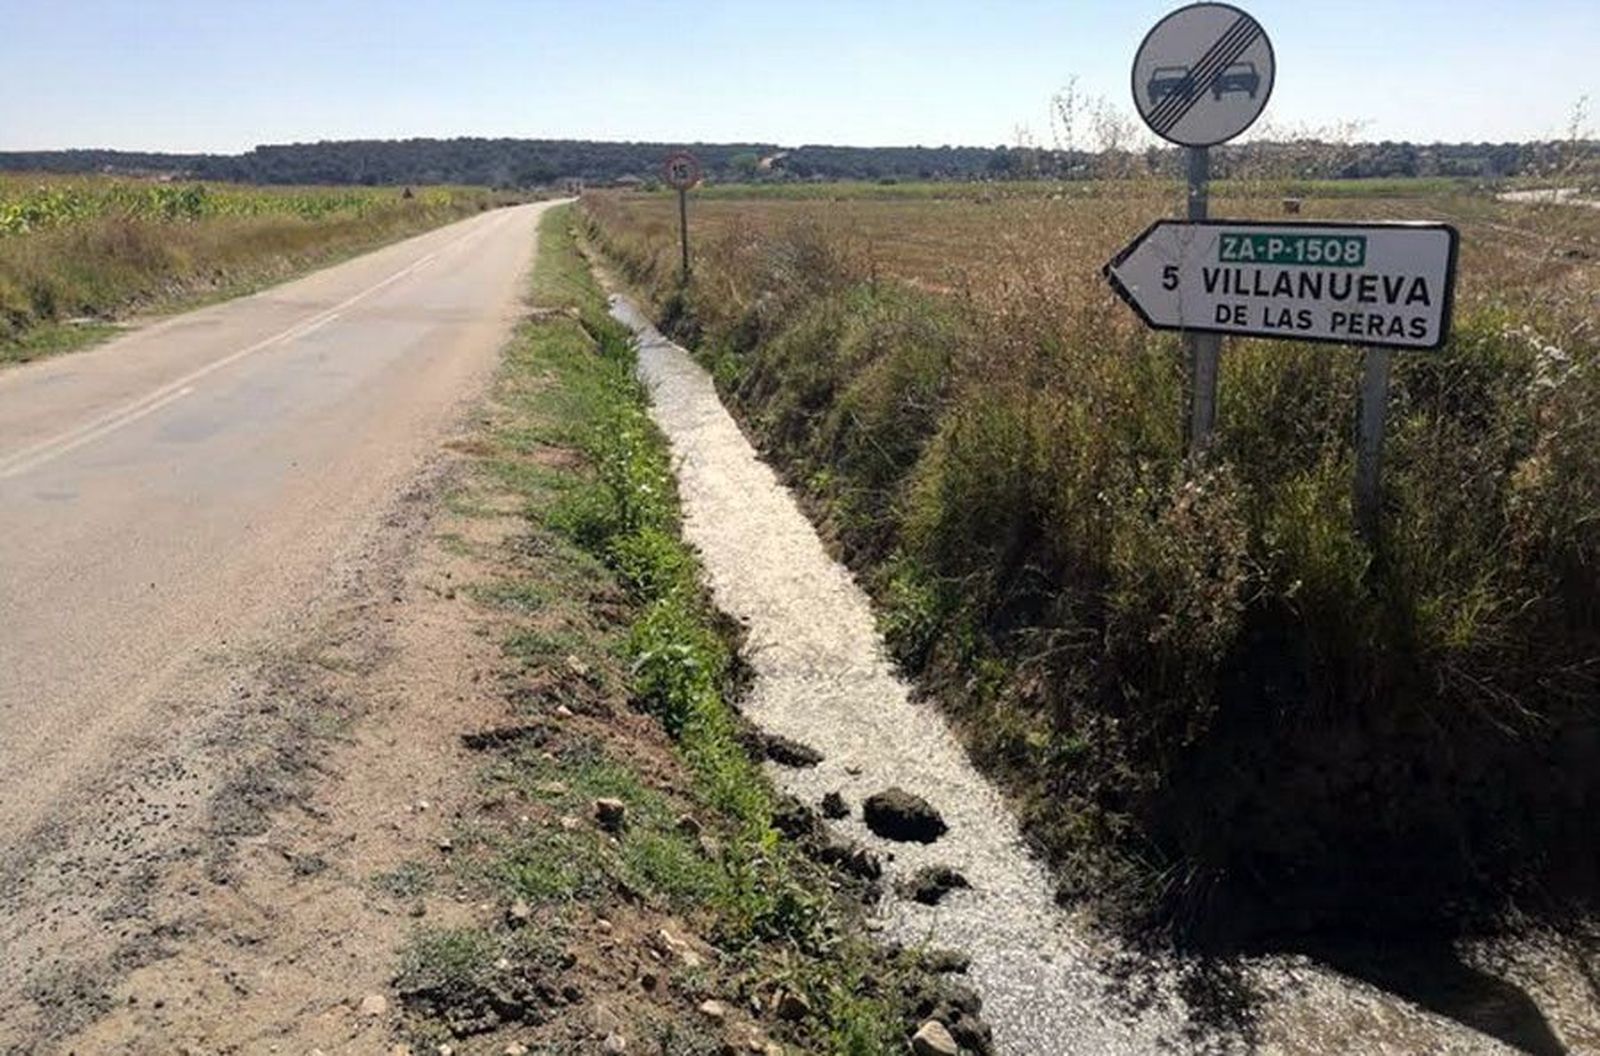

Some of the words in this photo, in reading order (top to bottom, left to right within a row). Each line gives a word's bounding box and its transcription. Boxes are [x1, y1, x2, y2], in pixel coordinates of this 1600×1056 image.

[1162, 265, 1180, 291] 5
[1203, 267, 1431, 306] VILLANUEVA
[1215, 304, 1248, 326] DE
[1263, 307, 1313, 330] LAS
[1330, 311, 1428, 339] PERAS
